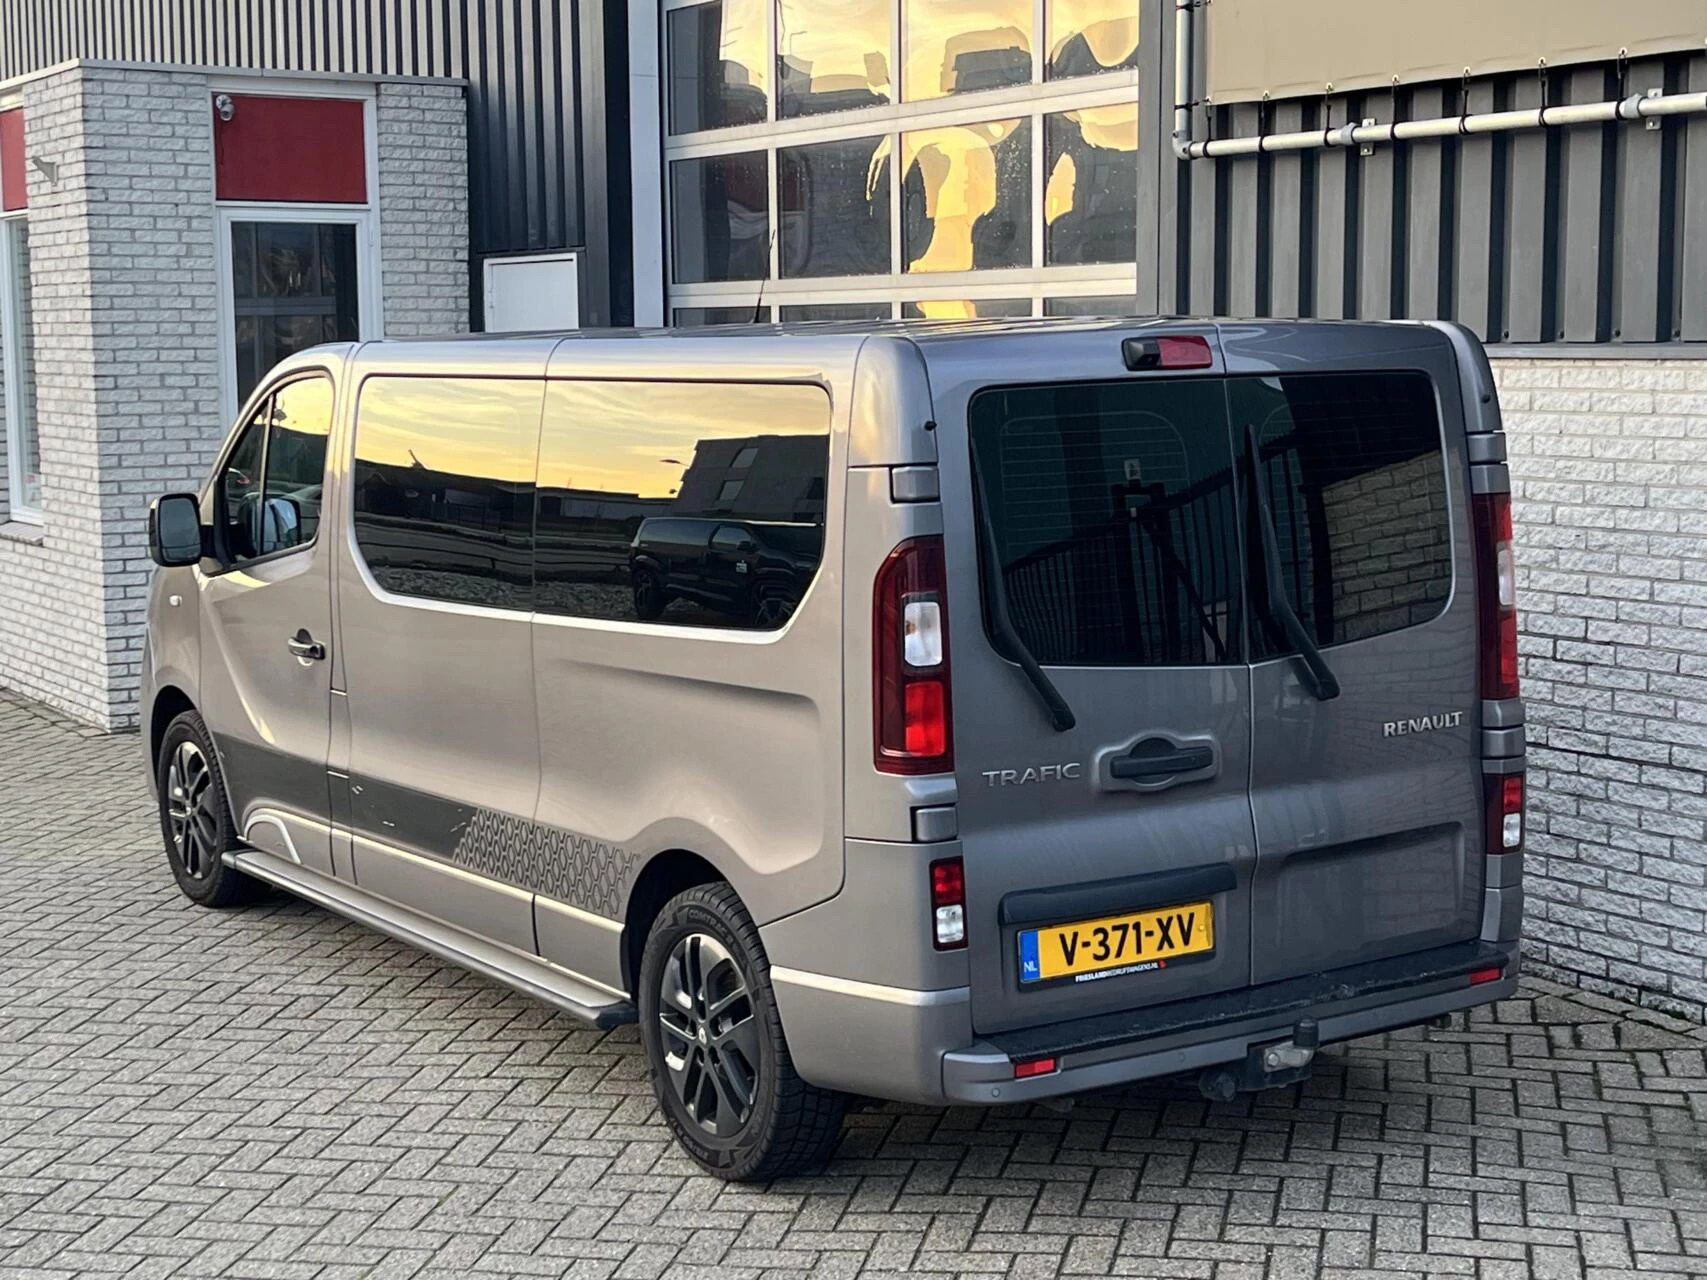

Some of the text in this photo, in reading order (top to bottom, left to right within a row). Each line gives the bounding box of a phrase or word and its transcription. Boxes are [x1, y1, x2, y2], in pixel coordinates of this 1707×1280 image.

[1383, 711, 1463, 737] RENAULT
[982, 762, 1081, 787] TRAFIC
[1059, 912, 1195, 967] V-371-XV
[1023, 961, 1038, 973] NL
